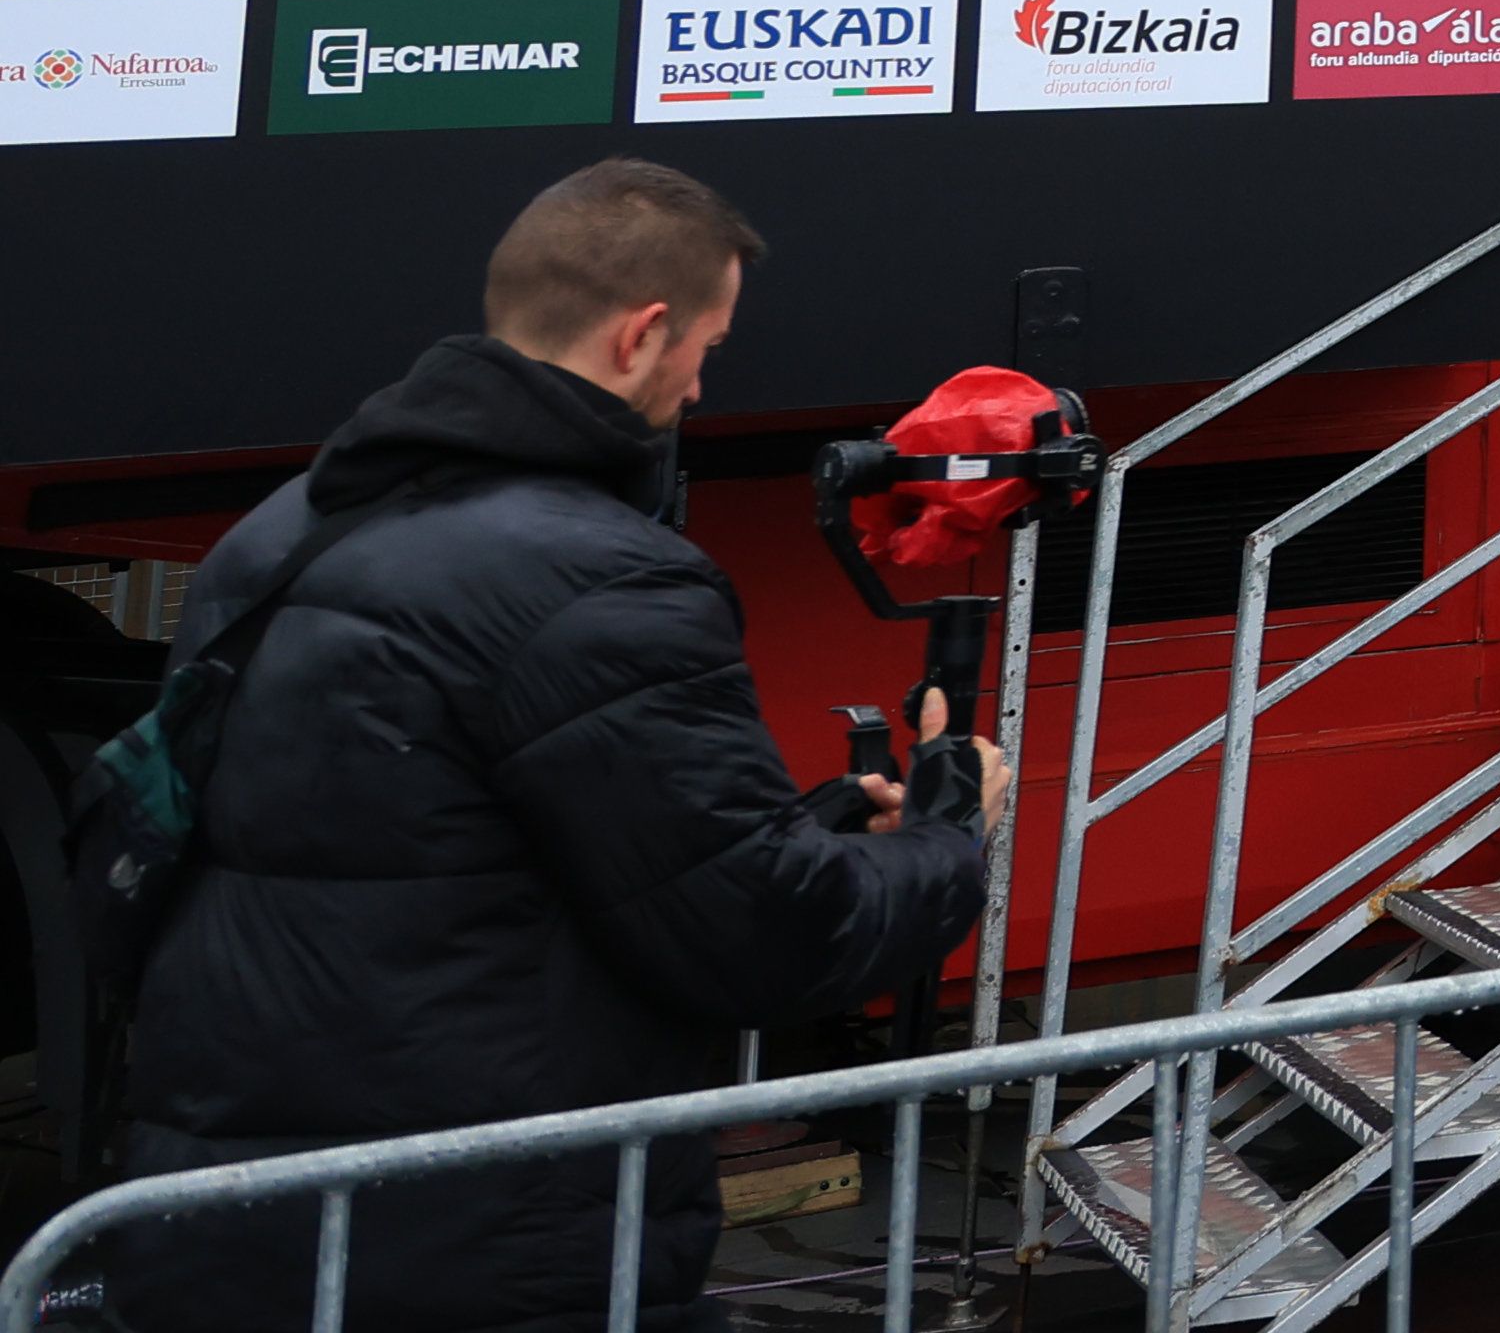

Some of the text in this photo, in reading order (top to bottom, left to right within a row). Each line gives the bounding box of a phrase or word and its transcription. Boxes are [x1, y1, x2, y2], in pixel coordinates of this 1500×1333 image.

[665, 7, 933, 53] EUSKADI
[1051, 8, 1240, 57] Bizkaia
[662, 57, 934, 85] BASQUE COUNTRY
